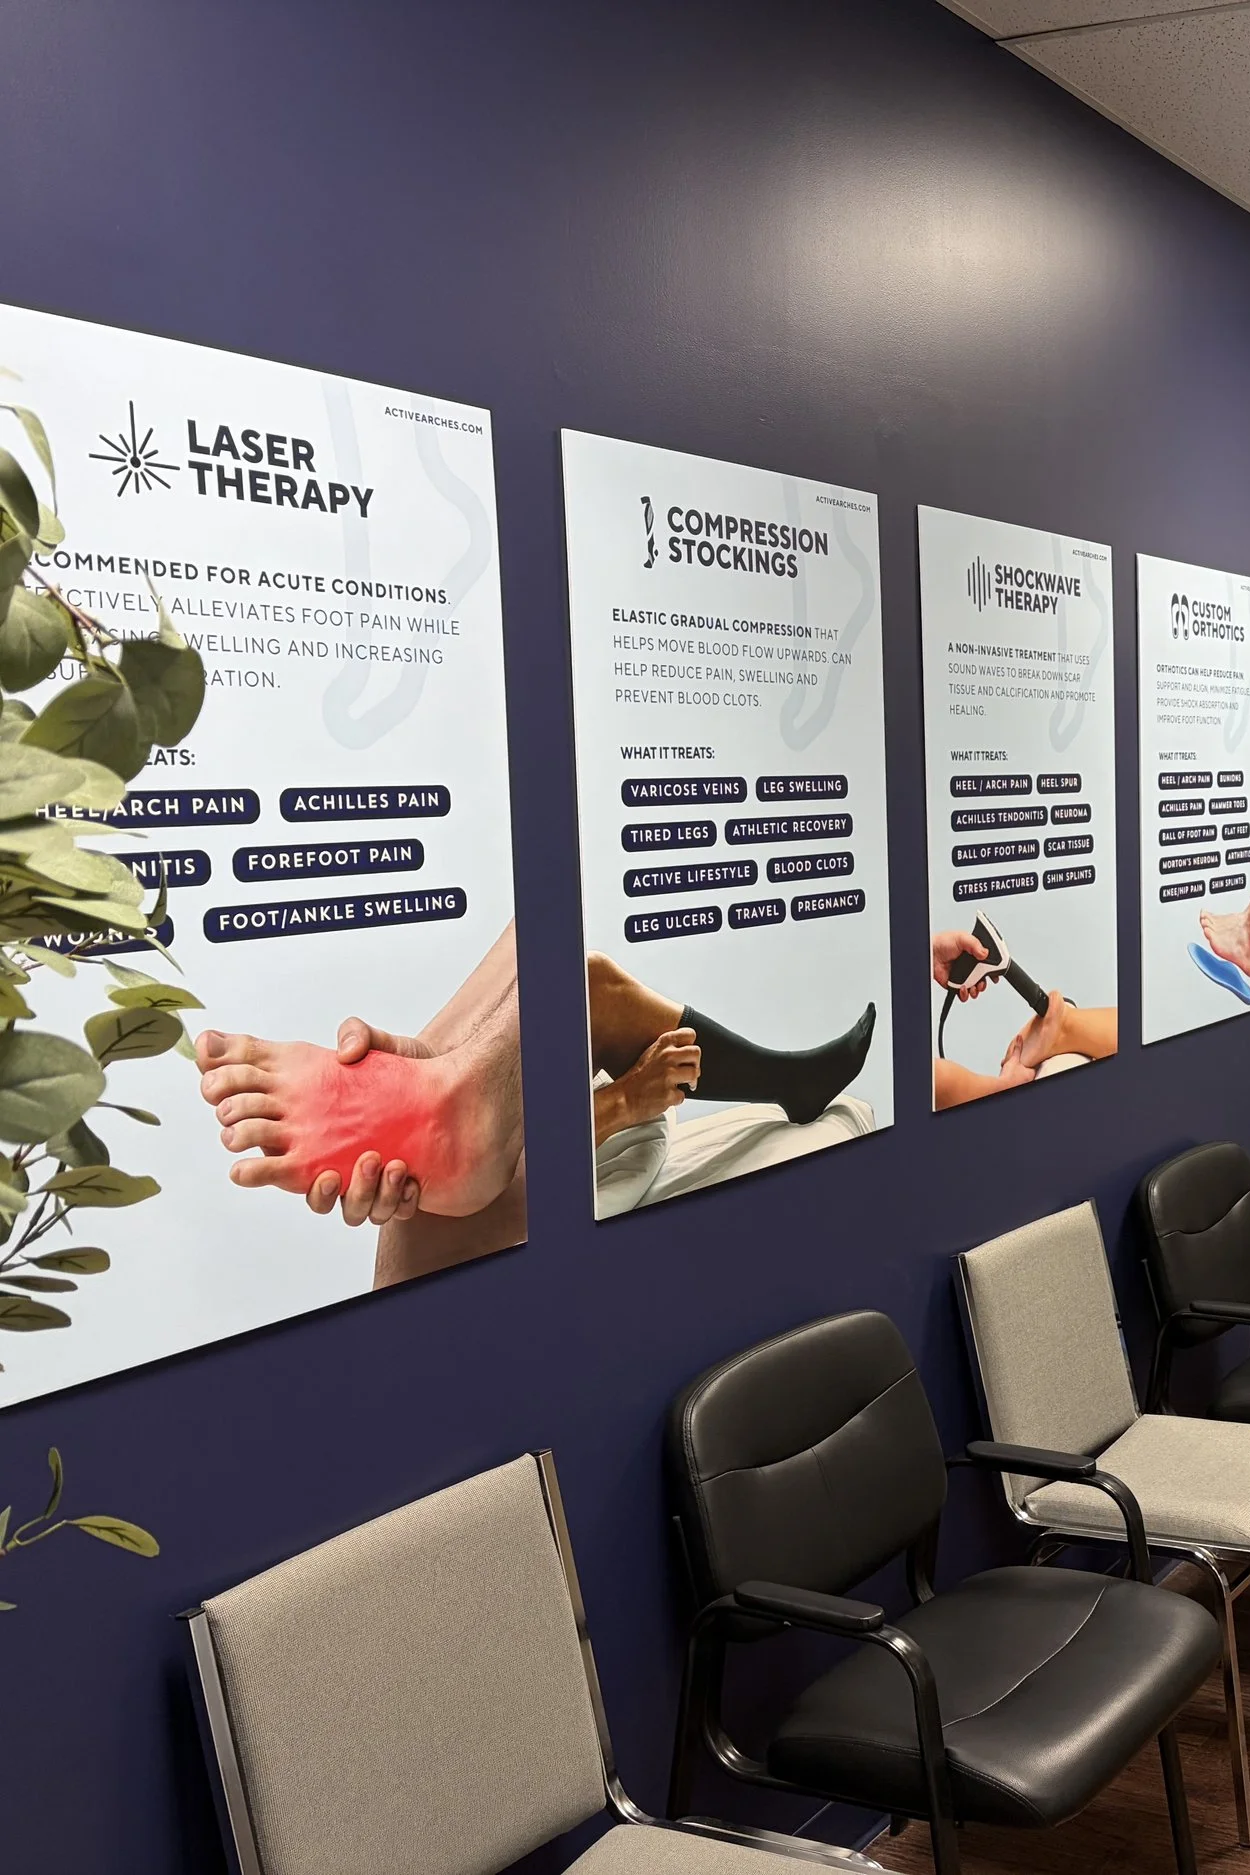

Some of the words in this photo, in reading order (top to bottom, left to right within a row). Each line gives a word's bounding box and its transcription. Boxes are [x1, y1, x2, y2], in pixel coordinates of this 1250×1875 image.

[384, 406, 483, 435] ACTIVEARCHES.COM
[187, 419, 316, 473] LASER
[187, 459, 374, 518] THERAPY
[815, 495, 871, 513] ACTIVEARCHES.COM
[667, 506, 828, 556] COMPRESSION
[668, 537, 798, 578] STOCKINGS
[206, 566, 250, 587] FOR
[257, 570, 325, 594] ACUTE
[331, 579, 451, 605] CONDITIONS.
[995, 564, 1081, 597] SHOCKWAVE
[995, 588, 1058, 615] THERAPY
[171, 596, 295, 623] ALLEVIATES
[302, 607, 352, 628] FOOT
[360, 612, 400, 632] PAIN
[406, 615, 459, 636] WHILE
[1192, 600, 1232, 622] CUSTOM
[612, 608, 666, 626] ELASTIC
[670, 614, 729, 631] GRADUAL
[732, 619, 812, 639] COMPRESSION
[815, 626, 837, 641] THAT
[1192, 620, 1245, 642] ORTHOTICS
[287, 638, 328, 659] AND
[335, 641, 443, 666] INCREASING
[613, 635, 654, 652] HELPS
[657, 638, 694, 654] MOVE
[698, 642, 739, 657] BLOOD
[742, 646, 774, 660] FLOW
[777, 648, 830, 664] UPWARDS.
[831, 651, 851, 665] CAN
[947, 642, 953, 653] A
[956, 643, 1013, 658] NON-INVASIVE
[1015, 648, 1056, 662] TREATMENT
[1058, 653, 1072, 664] THAT
[1074, 654, 1089, 665] USES
[614, 662, 647, 678] HELP
[651, 664, 702, 680] REDUCE
[705, 667, 735, 682] PAIN,
[738, 669, 793, 685] SWELLING
[795, 672, 817, 686] AND
[948, 663, 977, 675] SOUND
[978, 665, 1005, 677] WAVES
[1007, 667, 1016, 678] TO
[1018, 668, 1041, 679] BREAK
[1041, 670, 1063, 681] DOWN
[1064, 672, 1080, 682] SCAR
[1156, 664, 1187, 676] ORTHOTICS
[1187, 667, 1199, 677] CAN
[1199, 668, 1212, 678] HELP
[1213, 670, 1232, 679] REDUCE
[615, 689, 672, 704] PREVENT
[677, 691, 719, 706] BLOOD
[722, 693, 761, 707] CLOTS.
[949, 684, 975, 696] TISSUE
[977, 685, 994, 697] AND
[995, 686, 1049, 700] CALCIFICATION
[1050, 690, 1064, 700] AND
[1065, 690, 1095, 702] PROMOTE
[950, 704, 986, 716] HEALING.
[1156, 698, 1180, 708] PROVIDE
[1180, 699, 1198, 708] SHOCK
[620, 747, 657, 759] WHAT
[659, 747, 669, 759] IT
[671, 747, 714, 759] TREATS:
[950, 751, 972, 761] WHAT
[973, 751, 979, 761] IT
[981, 751, 1008, 761] TREATS:
[763, 781, 784, 793] LEG
[789, 781, 841, 793] SWELLING
[955, 780, 976, 790] HEEL
[985, 779, 1007, 789] ARCH
[1010, 779, 1027, 788] PAIN
[1041, 778, 1058, 788] HEEL
[1060, 778, 1077, 787] SPUR
[1161, 776, 1175, 784] HEEL
[1181, 775, 1196, 784] ARCH
[1197, 775, 1210, 783] PAIN
[630, 784, 697, 798] VARICOSE
[702, 783, 739, 795] VEINS
[192, 797, 245, 813] PAIN
[294, 792, 390, 812] ACHILLES
[398, 792, 440, 808] PAIN
[1161, 803, 1188, 812] ACHILLES
[1189, 802, 1202, 811] PAIN
[956, 813, 995, 825] ACHILLES
[998, 810, 1043, 822] TENDONITIS
[1055, 810, 1088, 819] NEUROMA
[631, 828, 671, 843] TIRED
[677, 827, 708, 840] LEGS
[732, 822, 787, 836] ATHLETIC
[792, 819, 845, 833] RECOVERY
[1162, 832, 1175, 841] BALL
[1177, 831, 1184, 839] OF
[1186, 829, 1200, 839] FOOT
[1202, 828, 1214, 837] PAIN
[1224, 827, 1235, 836] FLAT
[1236, 826, 1247, 834] FEET
[957, 849, 977, 860] BALL
[980, 848, 990, 858] OF
[994, 846, 1014, 857] FOOT
[1018, 844, 1035, 854] PAIN
[1047, 841, 1065, 852] SCAR
[1068, 839, 1089, 849] TISSUE
[248, 849, 361, 870] FOREFOOT
[370, 846, 413, 864] PAIN
[774, 861, 811, 875] BLOOD
[816, 858, 847, 871] CLOTS
[1192, 854, 1218, 866] NEUROMA
[632, 871, 680, 888] ACTIVE
[687, 866, 749, 883] LIFESTYLE
[958, 882, 987, 895] STRESS
[990, 877, 1033, 891] FRACTURES
[1046, 873, 1063, 884] SHIN
[1065, 870, 1091, 881] SPLINTS
[1211, 879, 1224, 889] SHIN
[1225, 877, 1243, 887] SPLINTS
[1162, 886, 1188, 898] KNEE/HIP
[1190, 884, 1202, 893] PAIN
[798, 894, 860, 912] PREGNANCY
[219, 904, 356, 931] FOOT/ANKLE
[364, 894, 457, 918] SWELLING
[735, 904, 779, 921] TRAVEL
[634, 918, 659, 933] LEG
[665, 913, 714, 930] ULCERS
